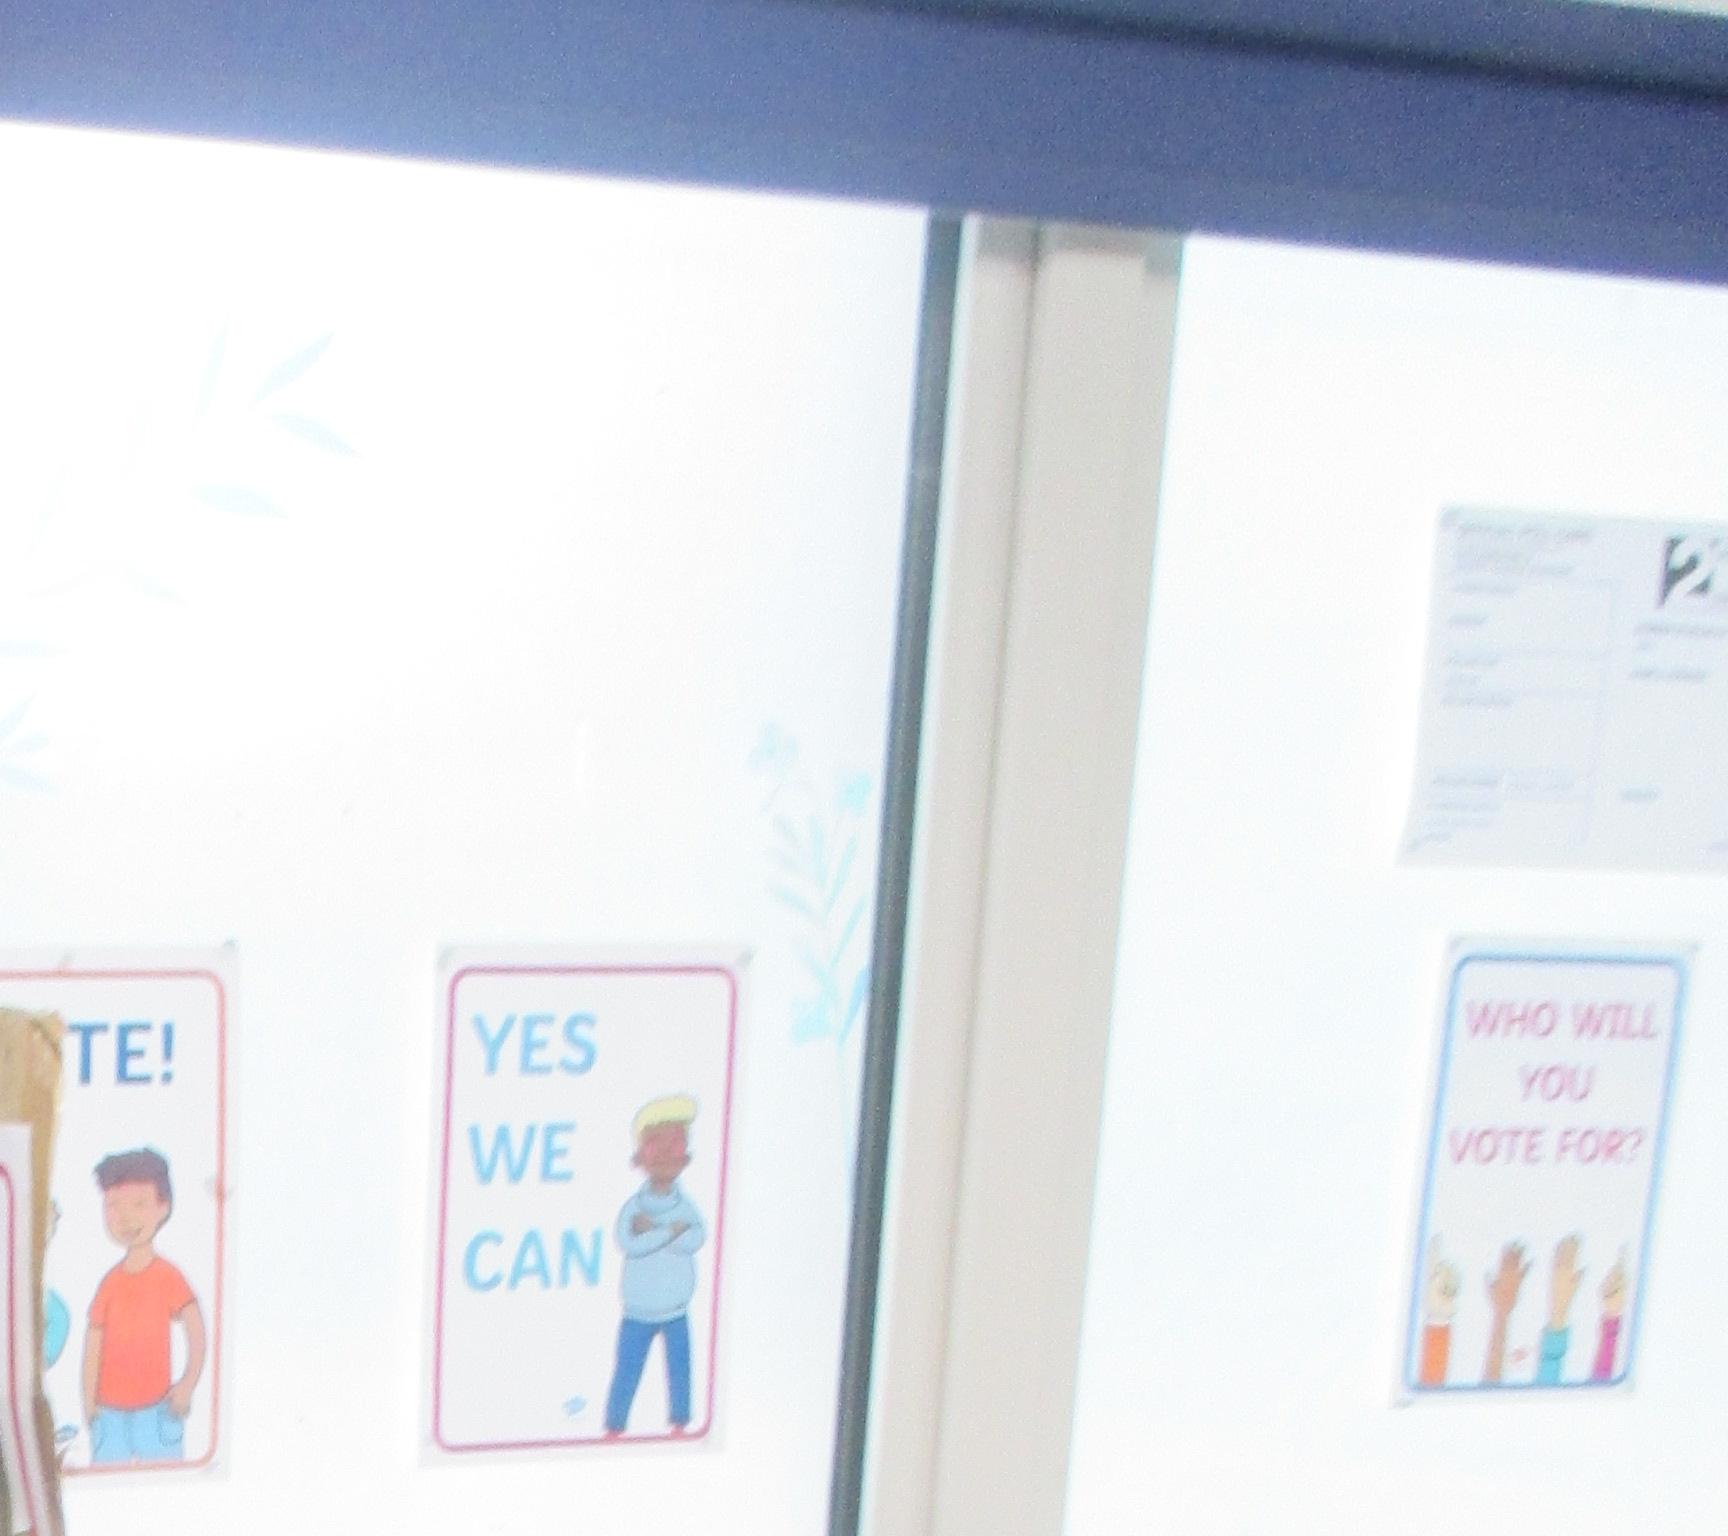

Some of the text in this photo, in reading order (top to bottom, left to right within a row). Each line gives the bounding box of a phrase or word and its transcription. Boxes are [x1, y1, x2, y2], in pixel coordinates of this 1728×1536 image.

[471, 1010, 599, 1078] YES
[1466, 1000, 1659, 1040] WHO WILL
[67, 1022, 175, 1086] TE!
[1520, 1064, 1595, 1103] YOU
[466, 1119, 577, 1186] WE
[1449, 1126, 1645, 1165] VOTE FOR?
[461, 1226, 604, 1293] CAN
